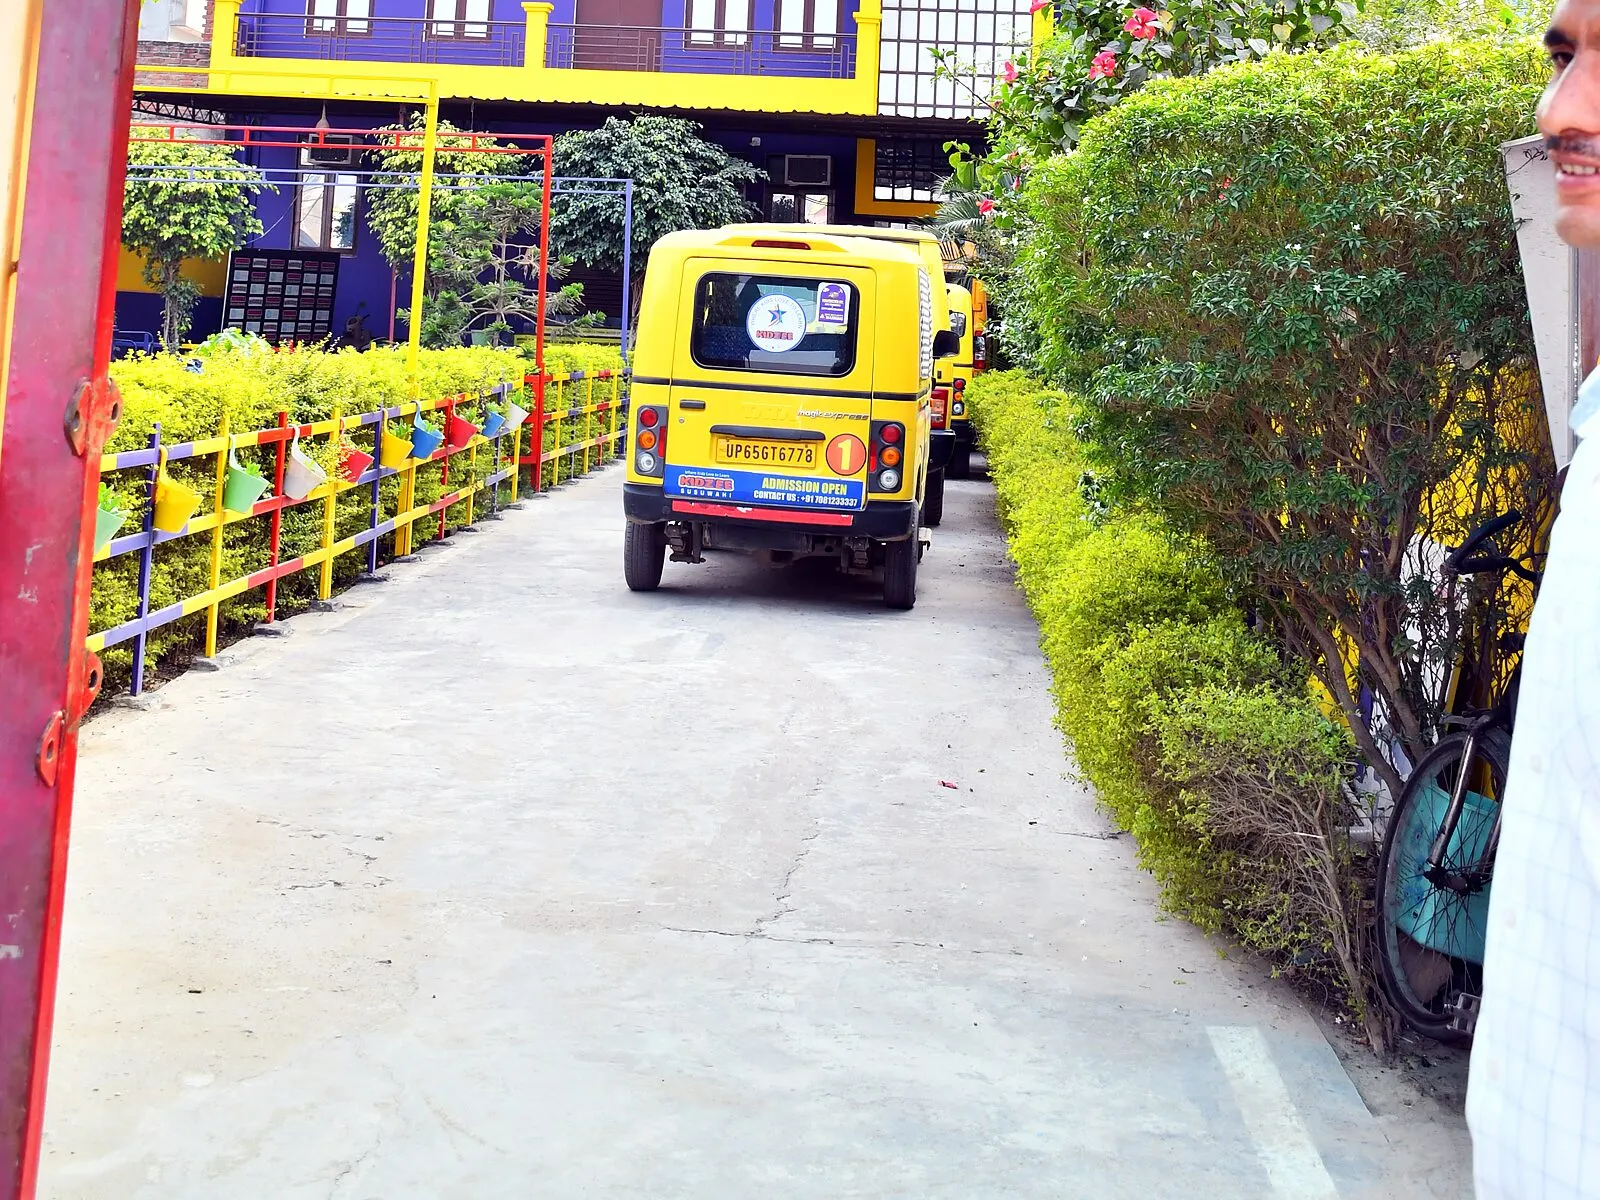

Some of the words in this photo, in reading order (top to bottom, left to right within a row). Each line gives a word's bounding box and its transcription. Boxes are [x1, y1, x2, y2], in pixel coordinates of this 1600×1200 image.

[756, 330, 793, 340] KIDZEE
[726, 443, 813, 463] UP65GT6778
[837, 439, 852, 471] 1
[679, 475, 733, 491] KIDZEE
[762, 477, 820, 493] ADMISSION
[821, 482, 848, 495] OPEN
[680, 488, 732, 498] SUSUWAHI
[753, 490, 785, 501] CONTACT
